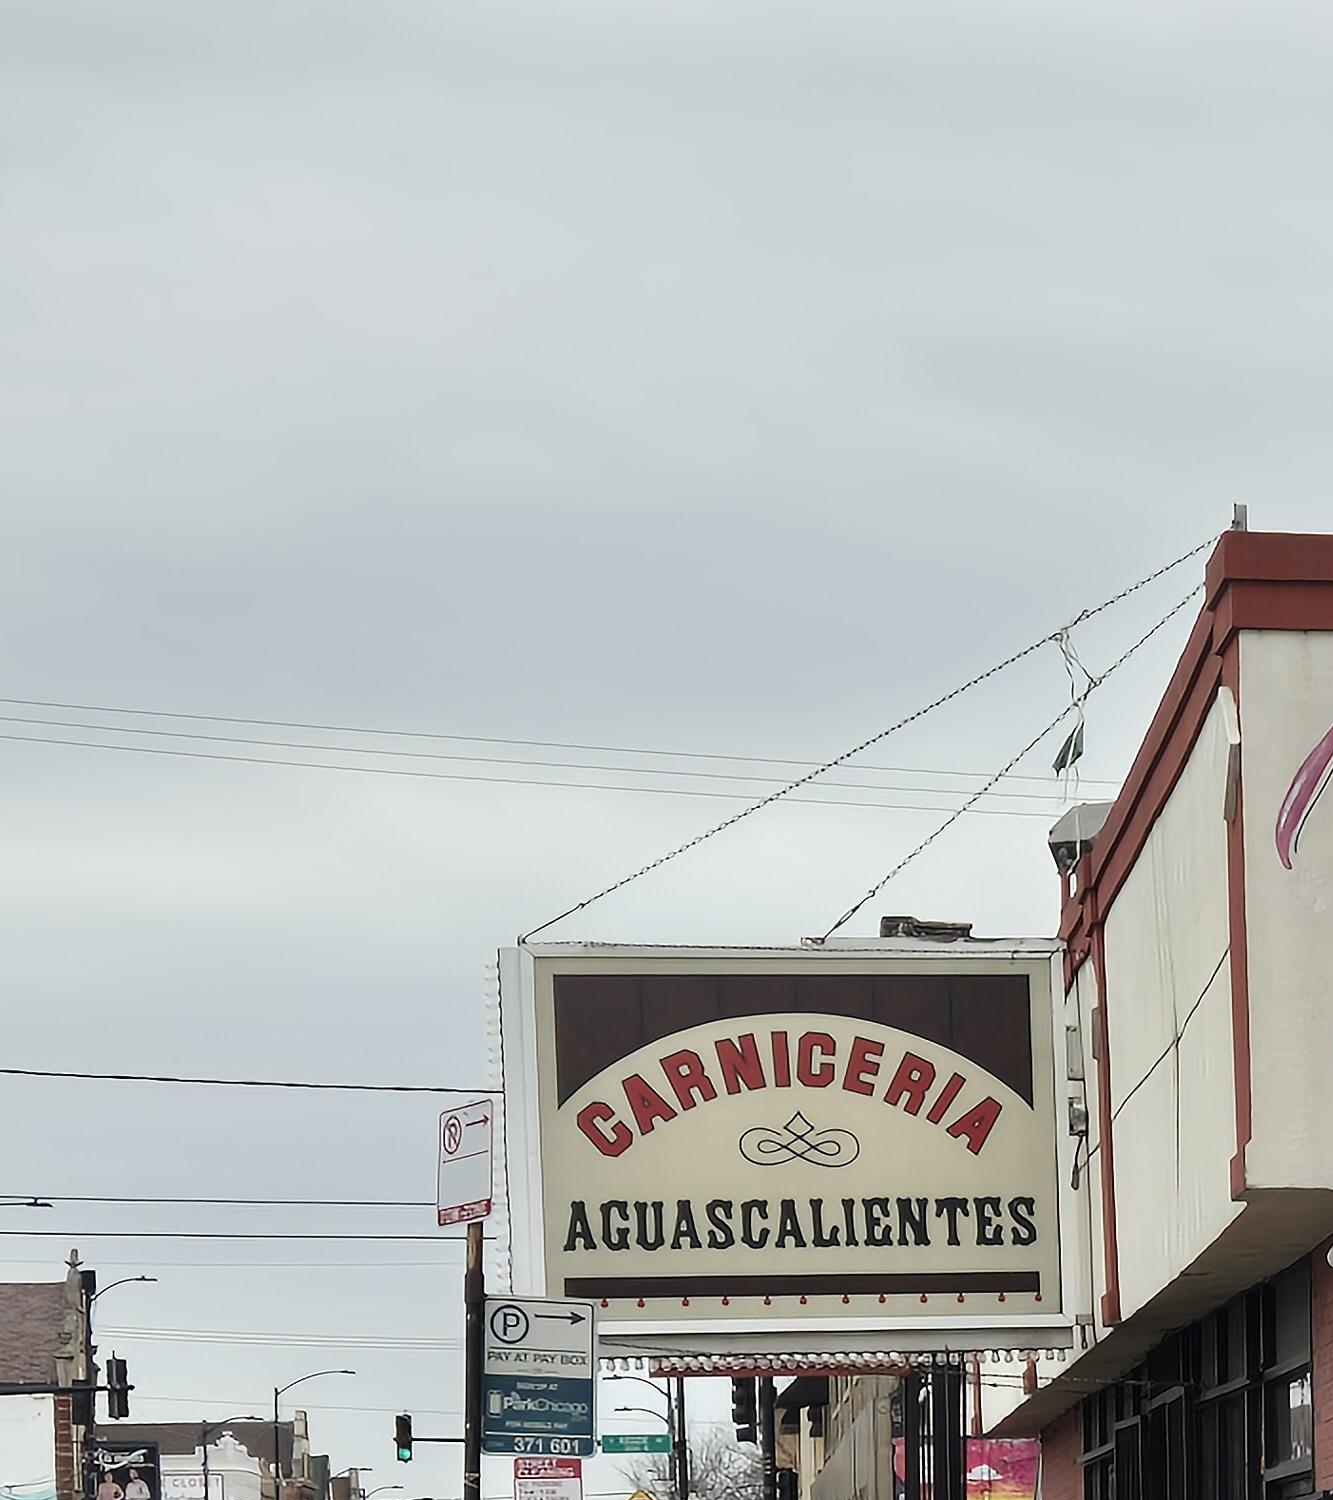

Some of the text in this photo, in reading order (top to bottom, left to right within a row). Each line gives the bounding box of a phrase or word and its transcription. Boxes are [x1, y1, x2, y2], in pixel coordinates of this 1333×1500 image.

[575, 1030, 1003, 1158] CARNICERIA
[563, 1196, 1039, 1252] AGUASCALIENTES
[513, 1437, 580, 1455] 371 601
